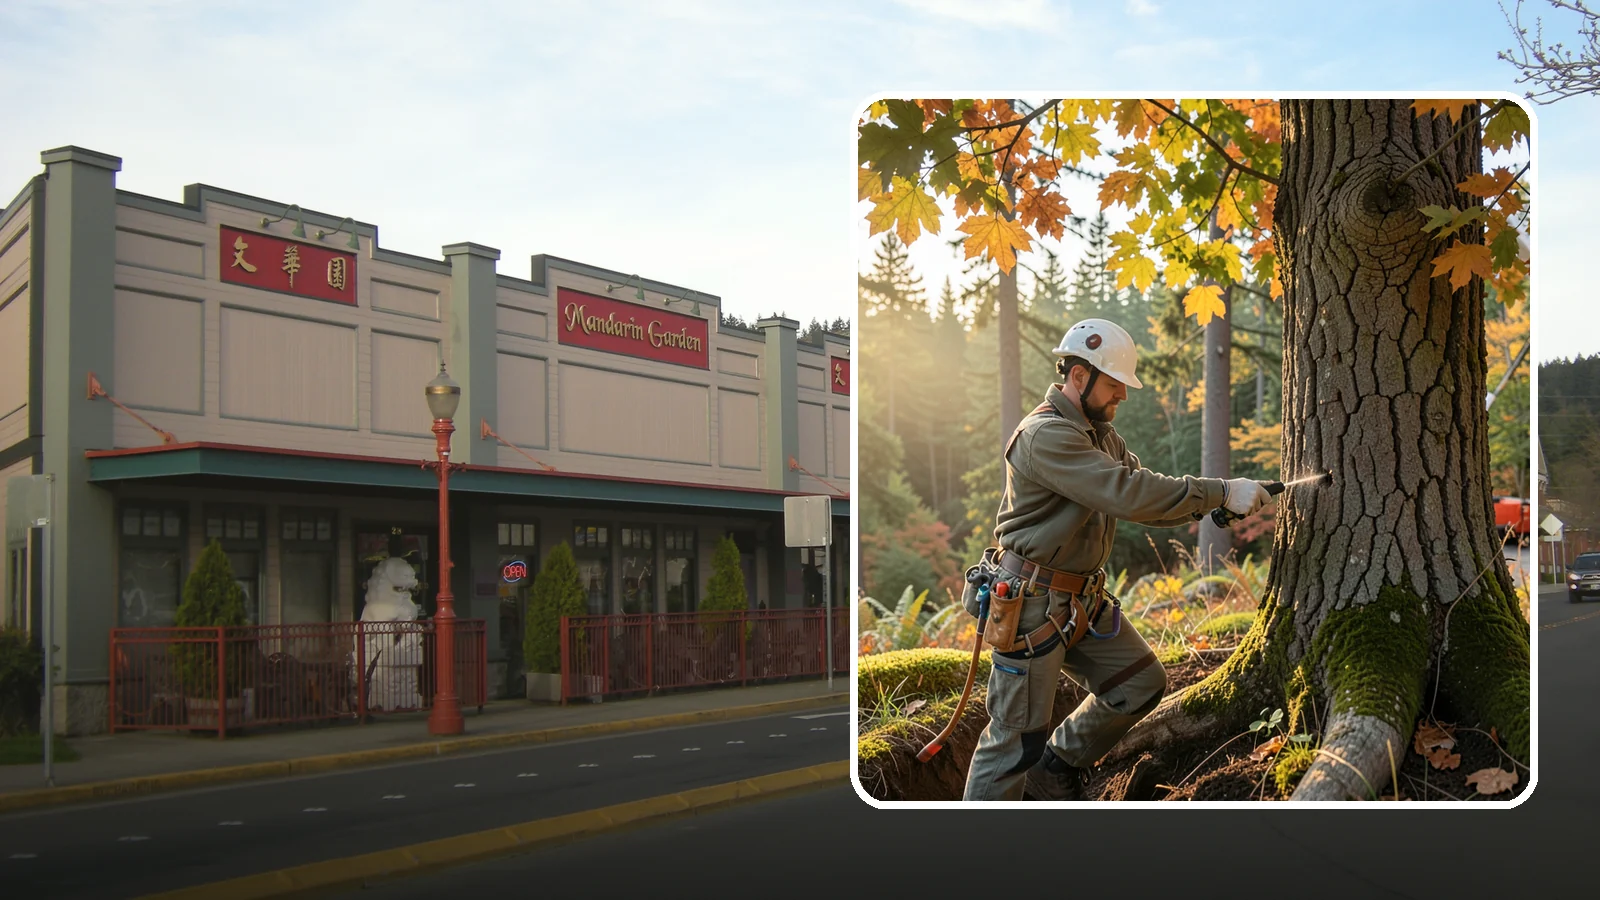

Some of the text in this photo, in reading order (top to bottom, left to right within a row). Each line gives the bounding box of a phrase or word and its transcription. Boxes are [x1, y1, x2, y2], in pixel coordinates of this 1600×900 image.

[231, 236, 346, 291] 文華園
[564, 302, 702, 352] Mandarin Garden
[503, 565, 527, 578] OPEN
